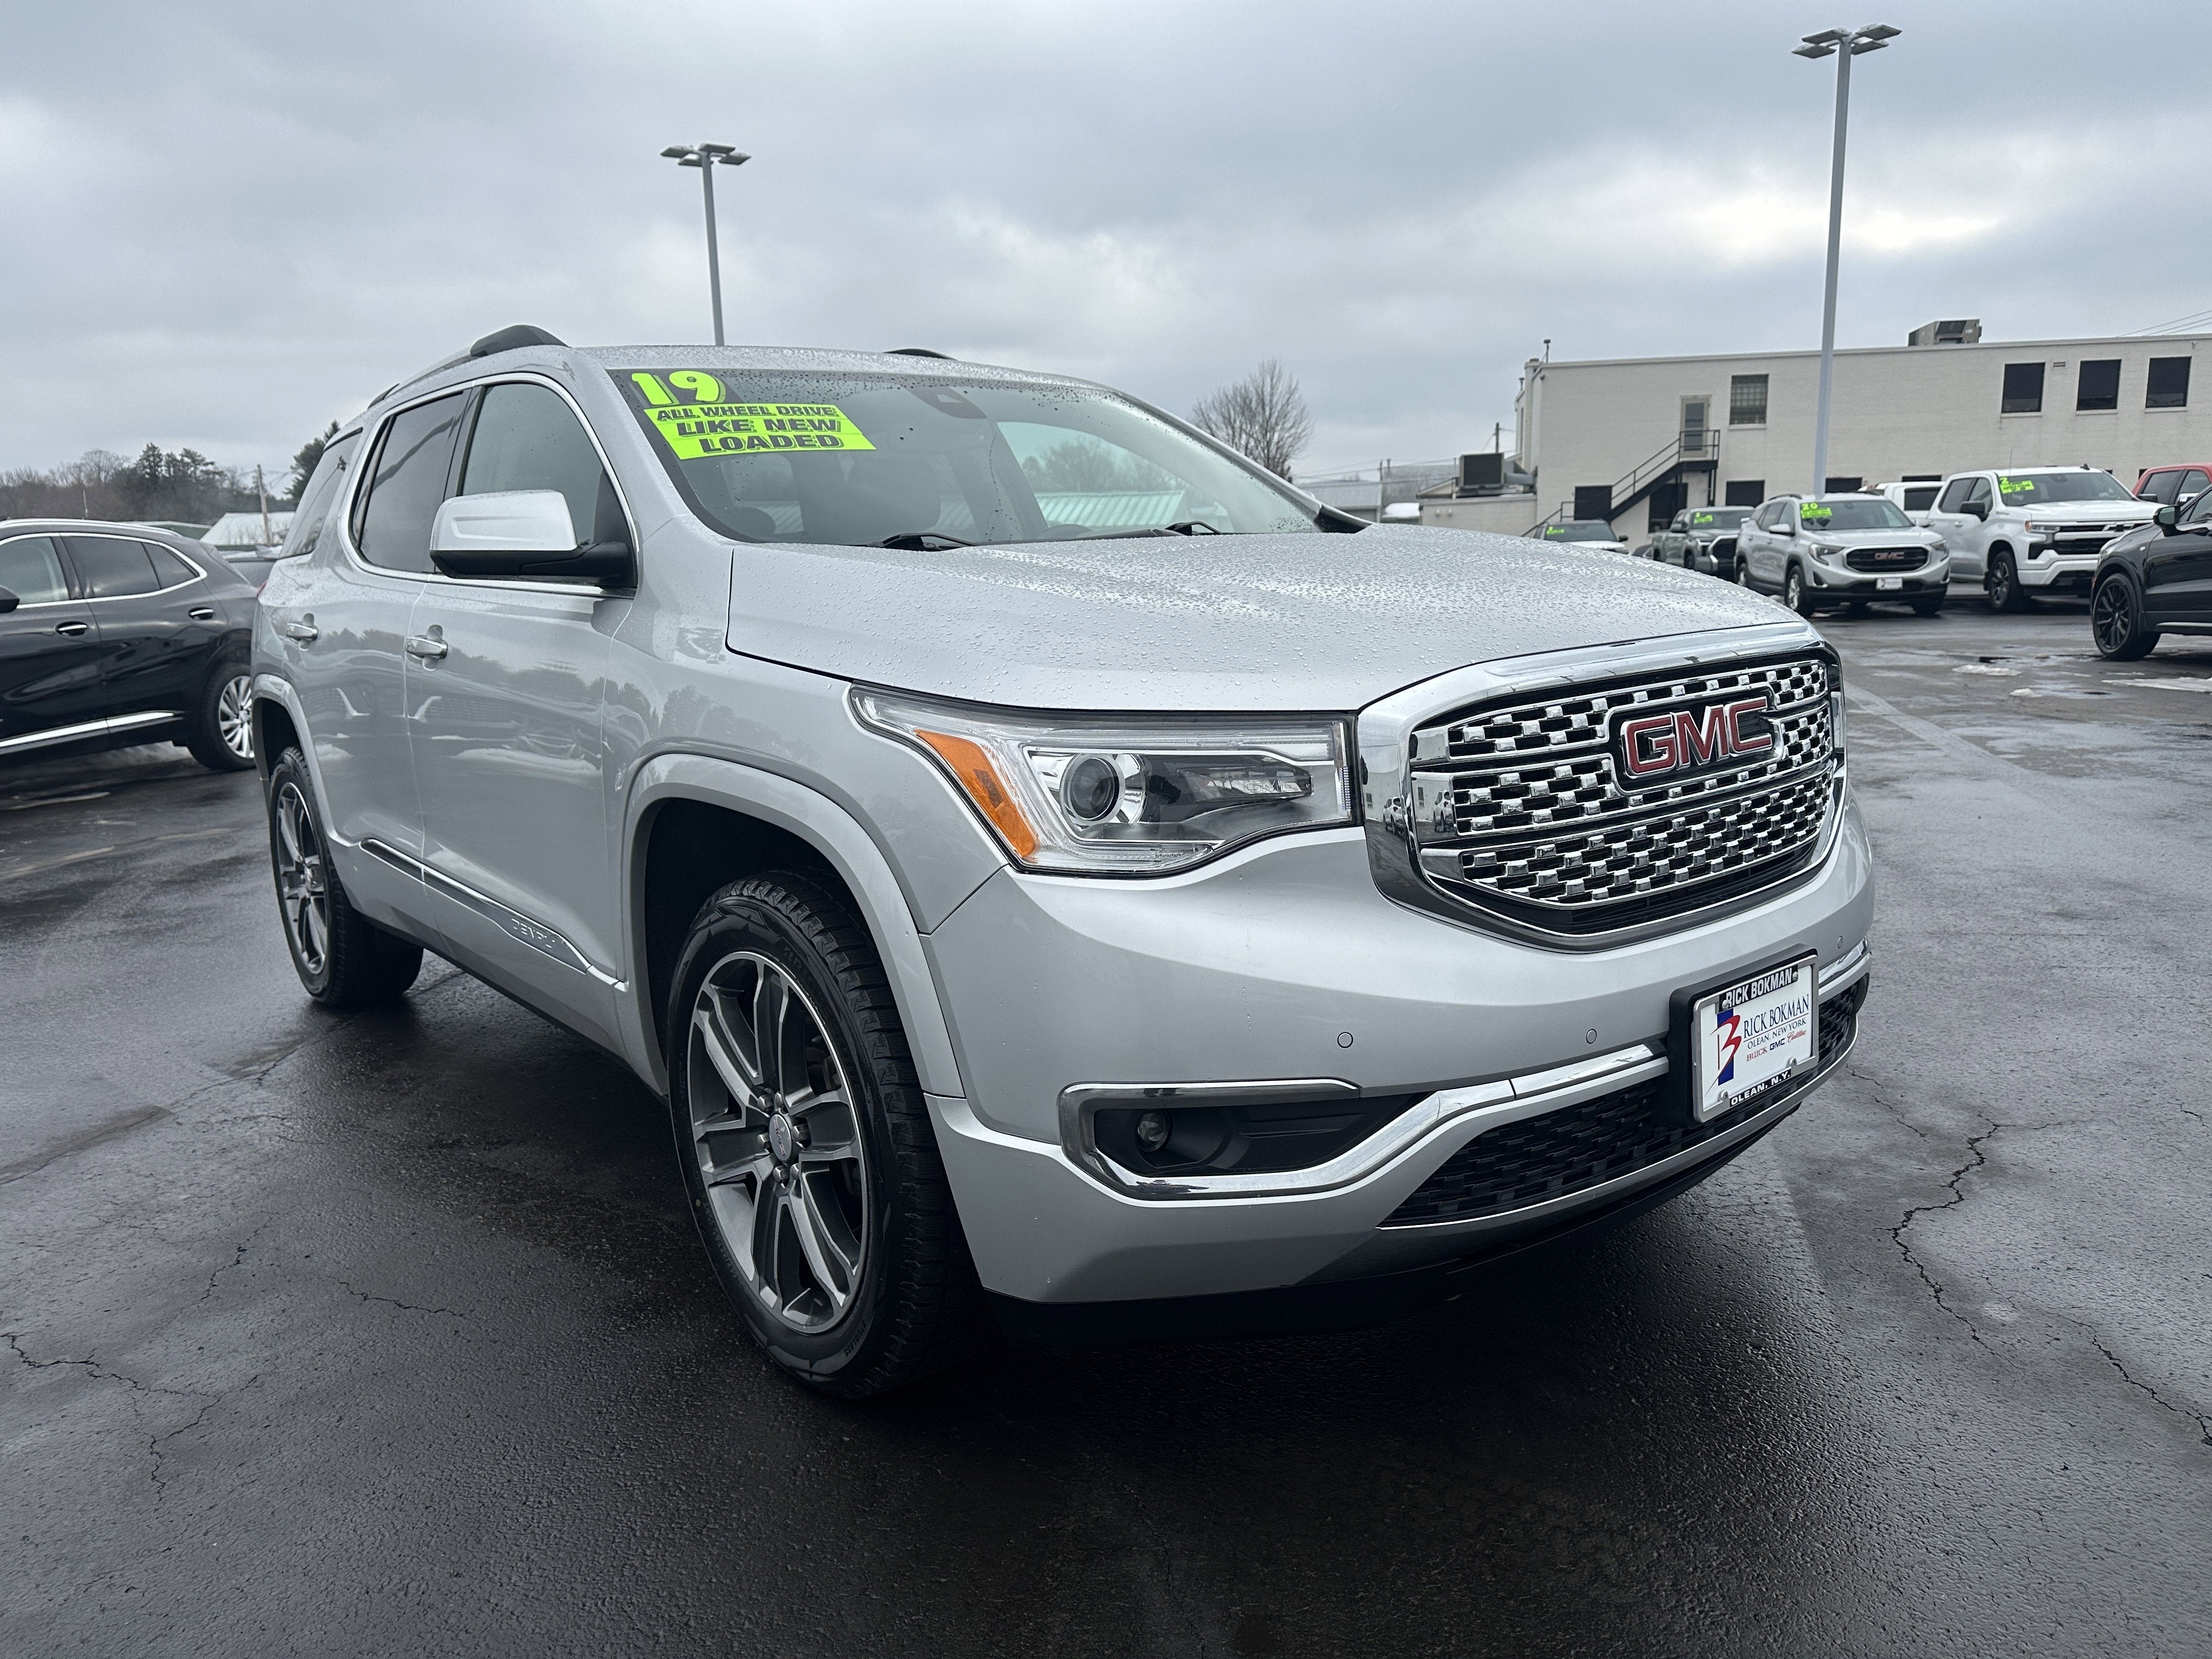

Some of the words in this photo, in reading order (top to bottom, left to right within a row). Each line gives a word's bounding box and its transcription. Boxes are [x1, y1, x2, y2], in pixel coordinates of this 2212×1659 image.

[631, 370, 725, 405] 19
[657, 409, 700, 421] ALL
[701, 406, 774, 417] WHEEL
[776, 406, 839, 417] DRIVE
[677, 419, 757, 437] LIKE
[763, 419, 840, 432] NEW
[699, 435, 844, 453] LOADED
[1875, 551, 1904, 560] GMC
[1621, 696, 1773, 779] GMC
[1726, 985, 1749, 1008] RICK
[1751, 968, 1792, 999] BOKMAN
[1743, 1012, 1767, 1039] RICK
[1769, 994, 1809, 1027] BOKMAN
[1748, 1034, 1771, 1049] OLEAN,
[1773, 1025, 1787, 1039] NEW
[1788, 1017, 1807, 1030] YORK
[1747, 1046, 1768, 1061] BUICK
[1770, 1038, 1785, 1051] GMC
[1731, 1083, 1768, 1105] OLEAN,
[1771, 1071, 1791, 1085] N.Y.
